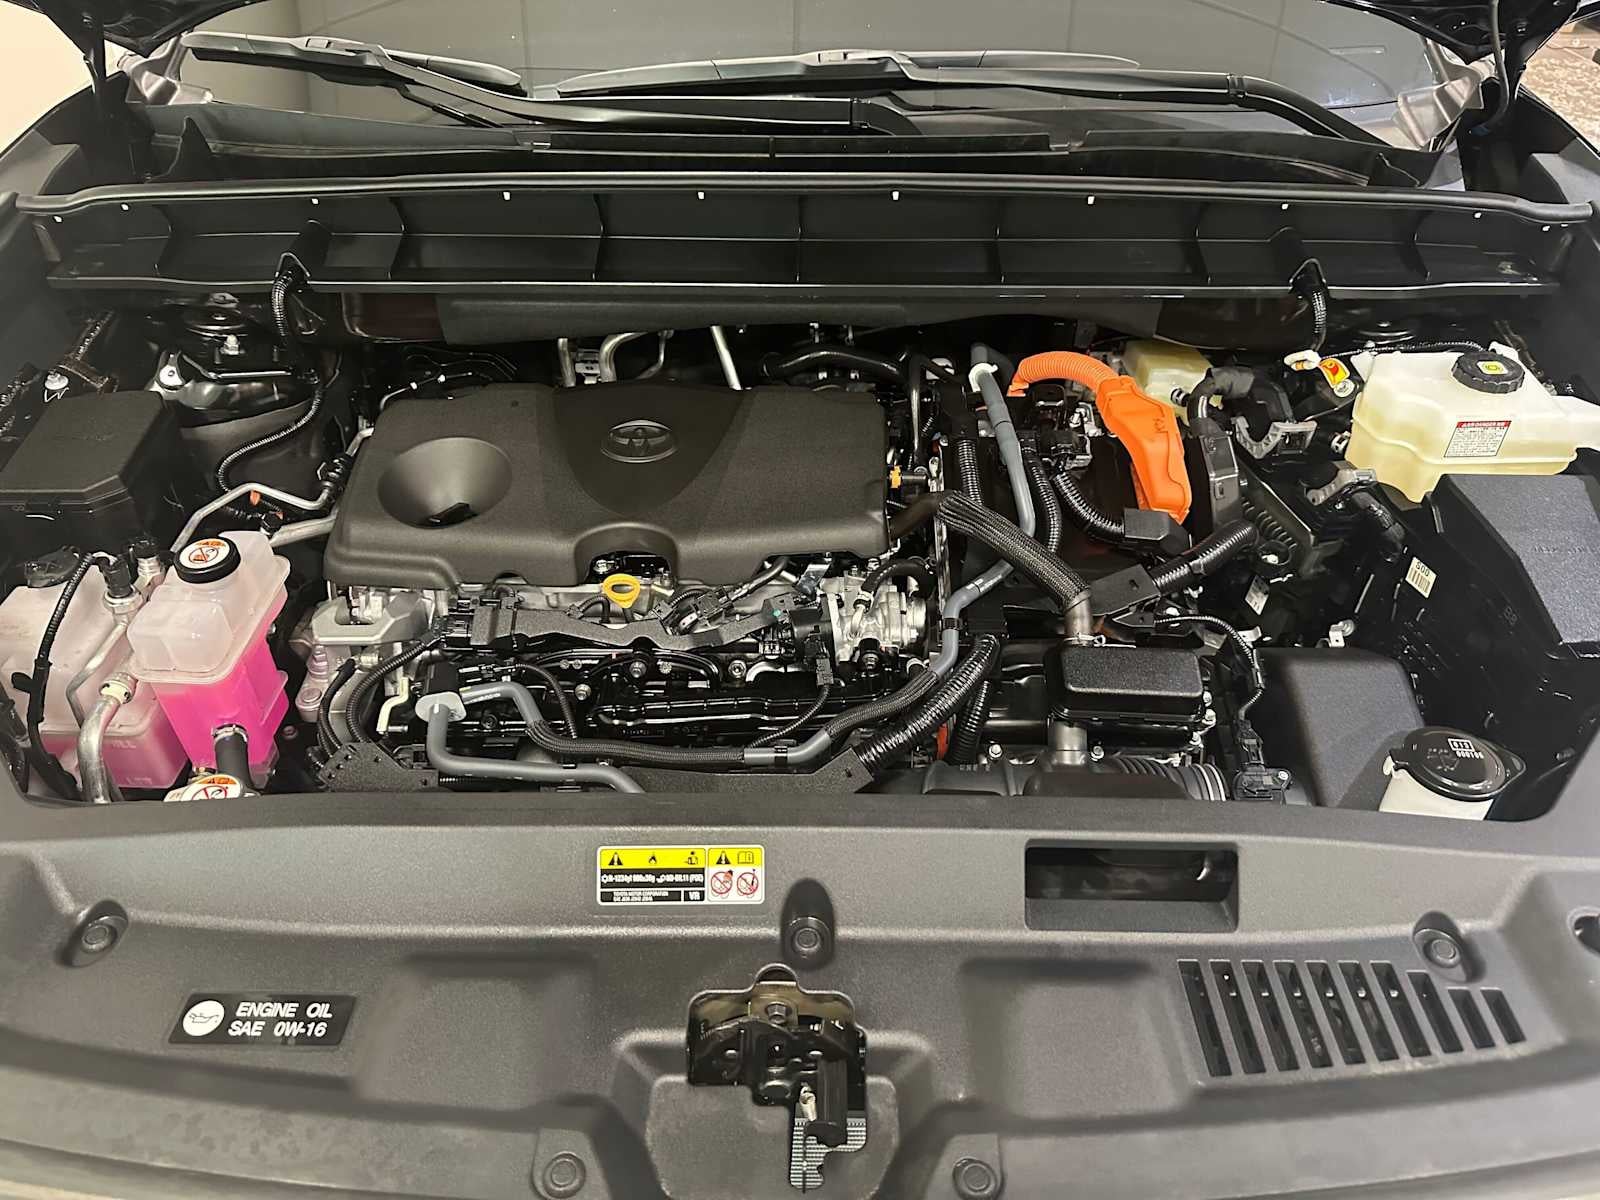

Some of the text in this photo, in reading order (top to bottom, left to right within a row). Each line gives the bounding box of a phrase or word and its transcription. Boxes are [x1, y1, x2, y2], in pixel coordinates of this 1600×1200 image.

[235, 1001, 333, 1019] ENGINE OIL
[227, 1020, 327, 1038] SAE 0W-16
